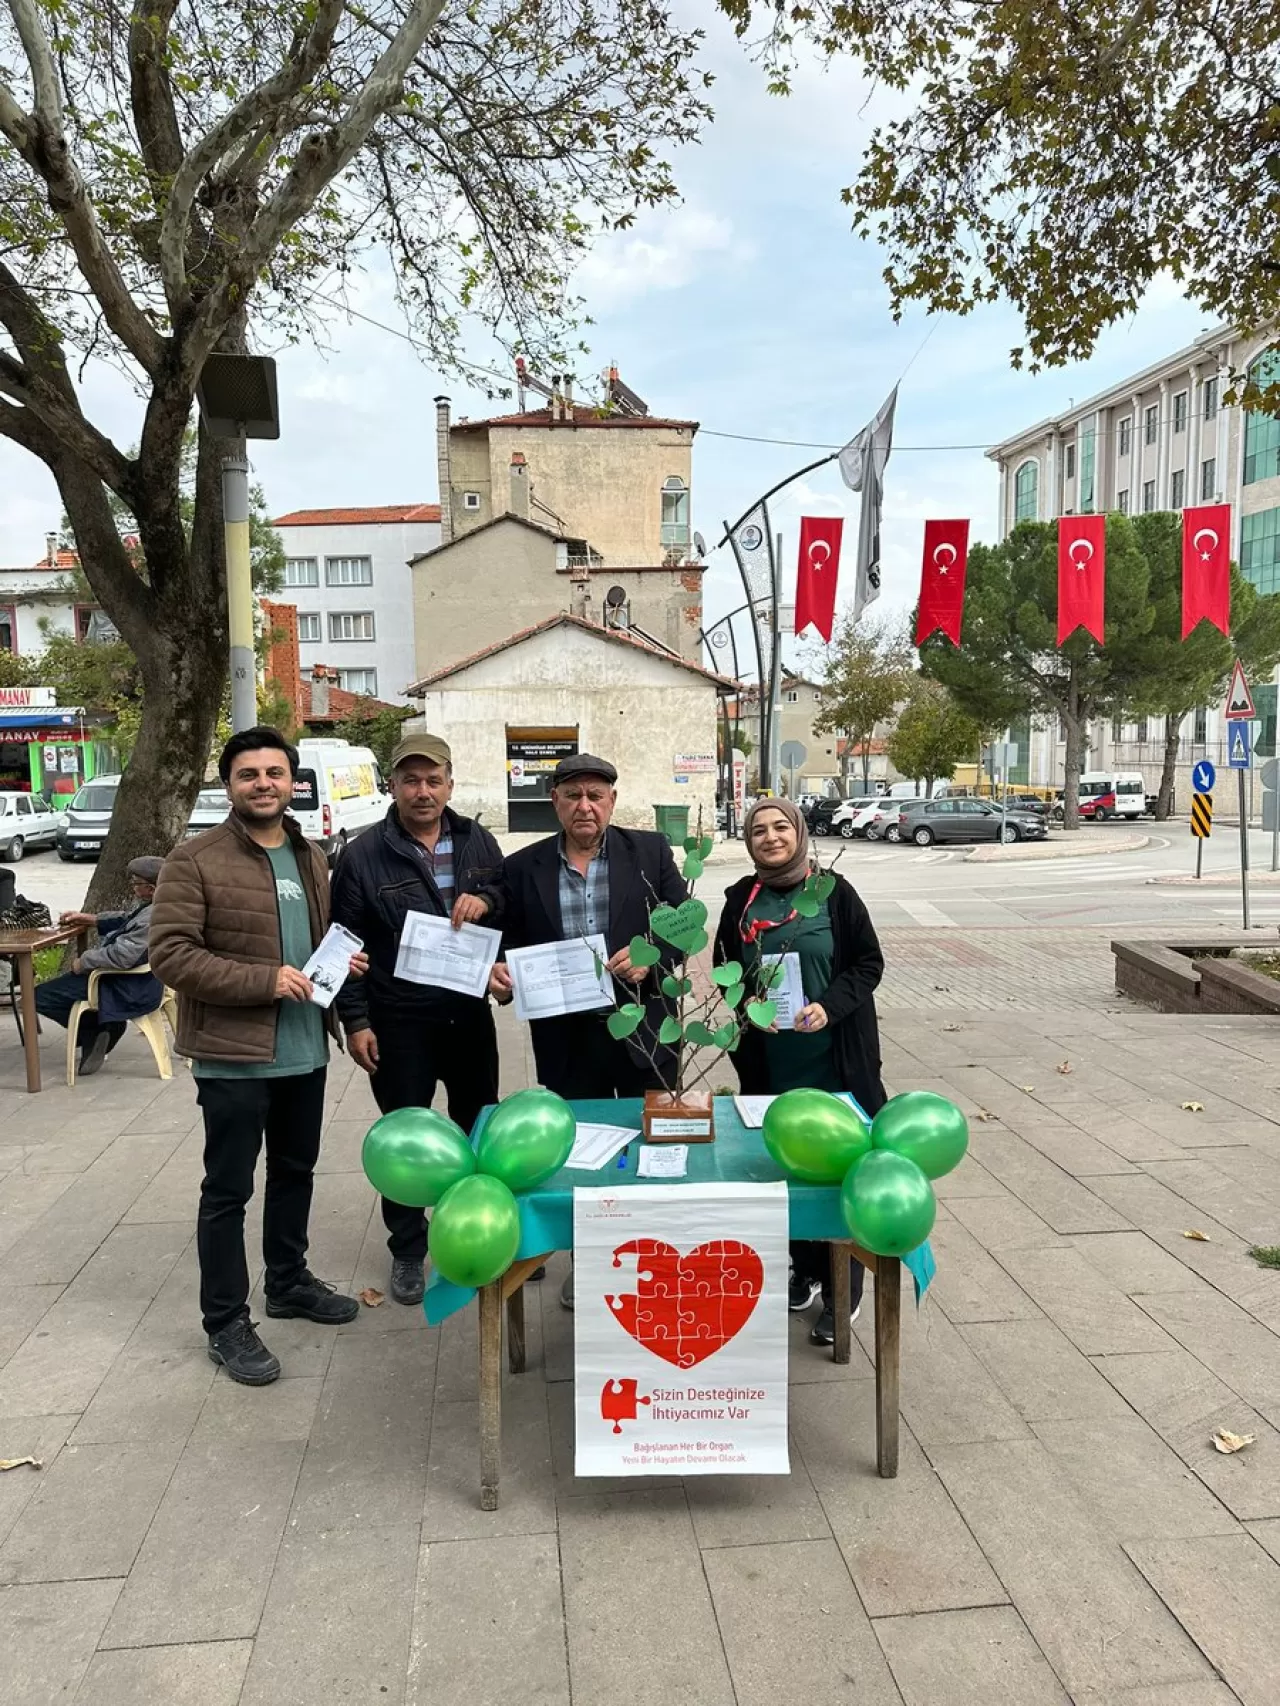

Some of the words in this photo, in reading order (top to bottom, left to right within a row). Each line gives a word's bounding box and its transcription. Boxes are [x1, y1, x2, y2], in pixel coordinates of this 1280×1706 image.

[652, 1388, 684, 1401] Sizin
[687, 1387, 765, 1402] Desteğinize
[652, 1405, 725, 1423] İhtiyacımız
[727, 1406, 750, 1420] Var
[633, 1443, 678, 1453] Bağışlanan
[679, 1443, 695, 1451] Her
[696, 1442, 708, 1451] Bir
[709, 1441, 735, 1452] Organ
[622, 1455, 639, 1464] Yeni
[640, 1456, 652, 1464] Bir
[653, 1455, 686, 1465] Hayatın
[686, 1454, 717, 1464] Devamı
[718, 1453, 747, 1463] Olacak
